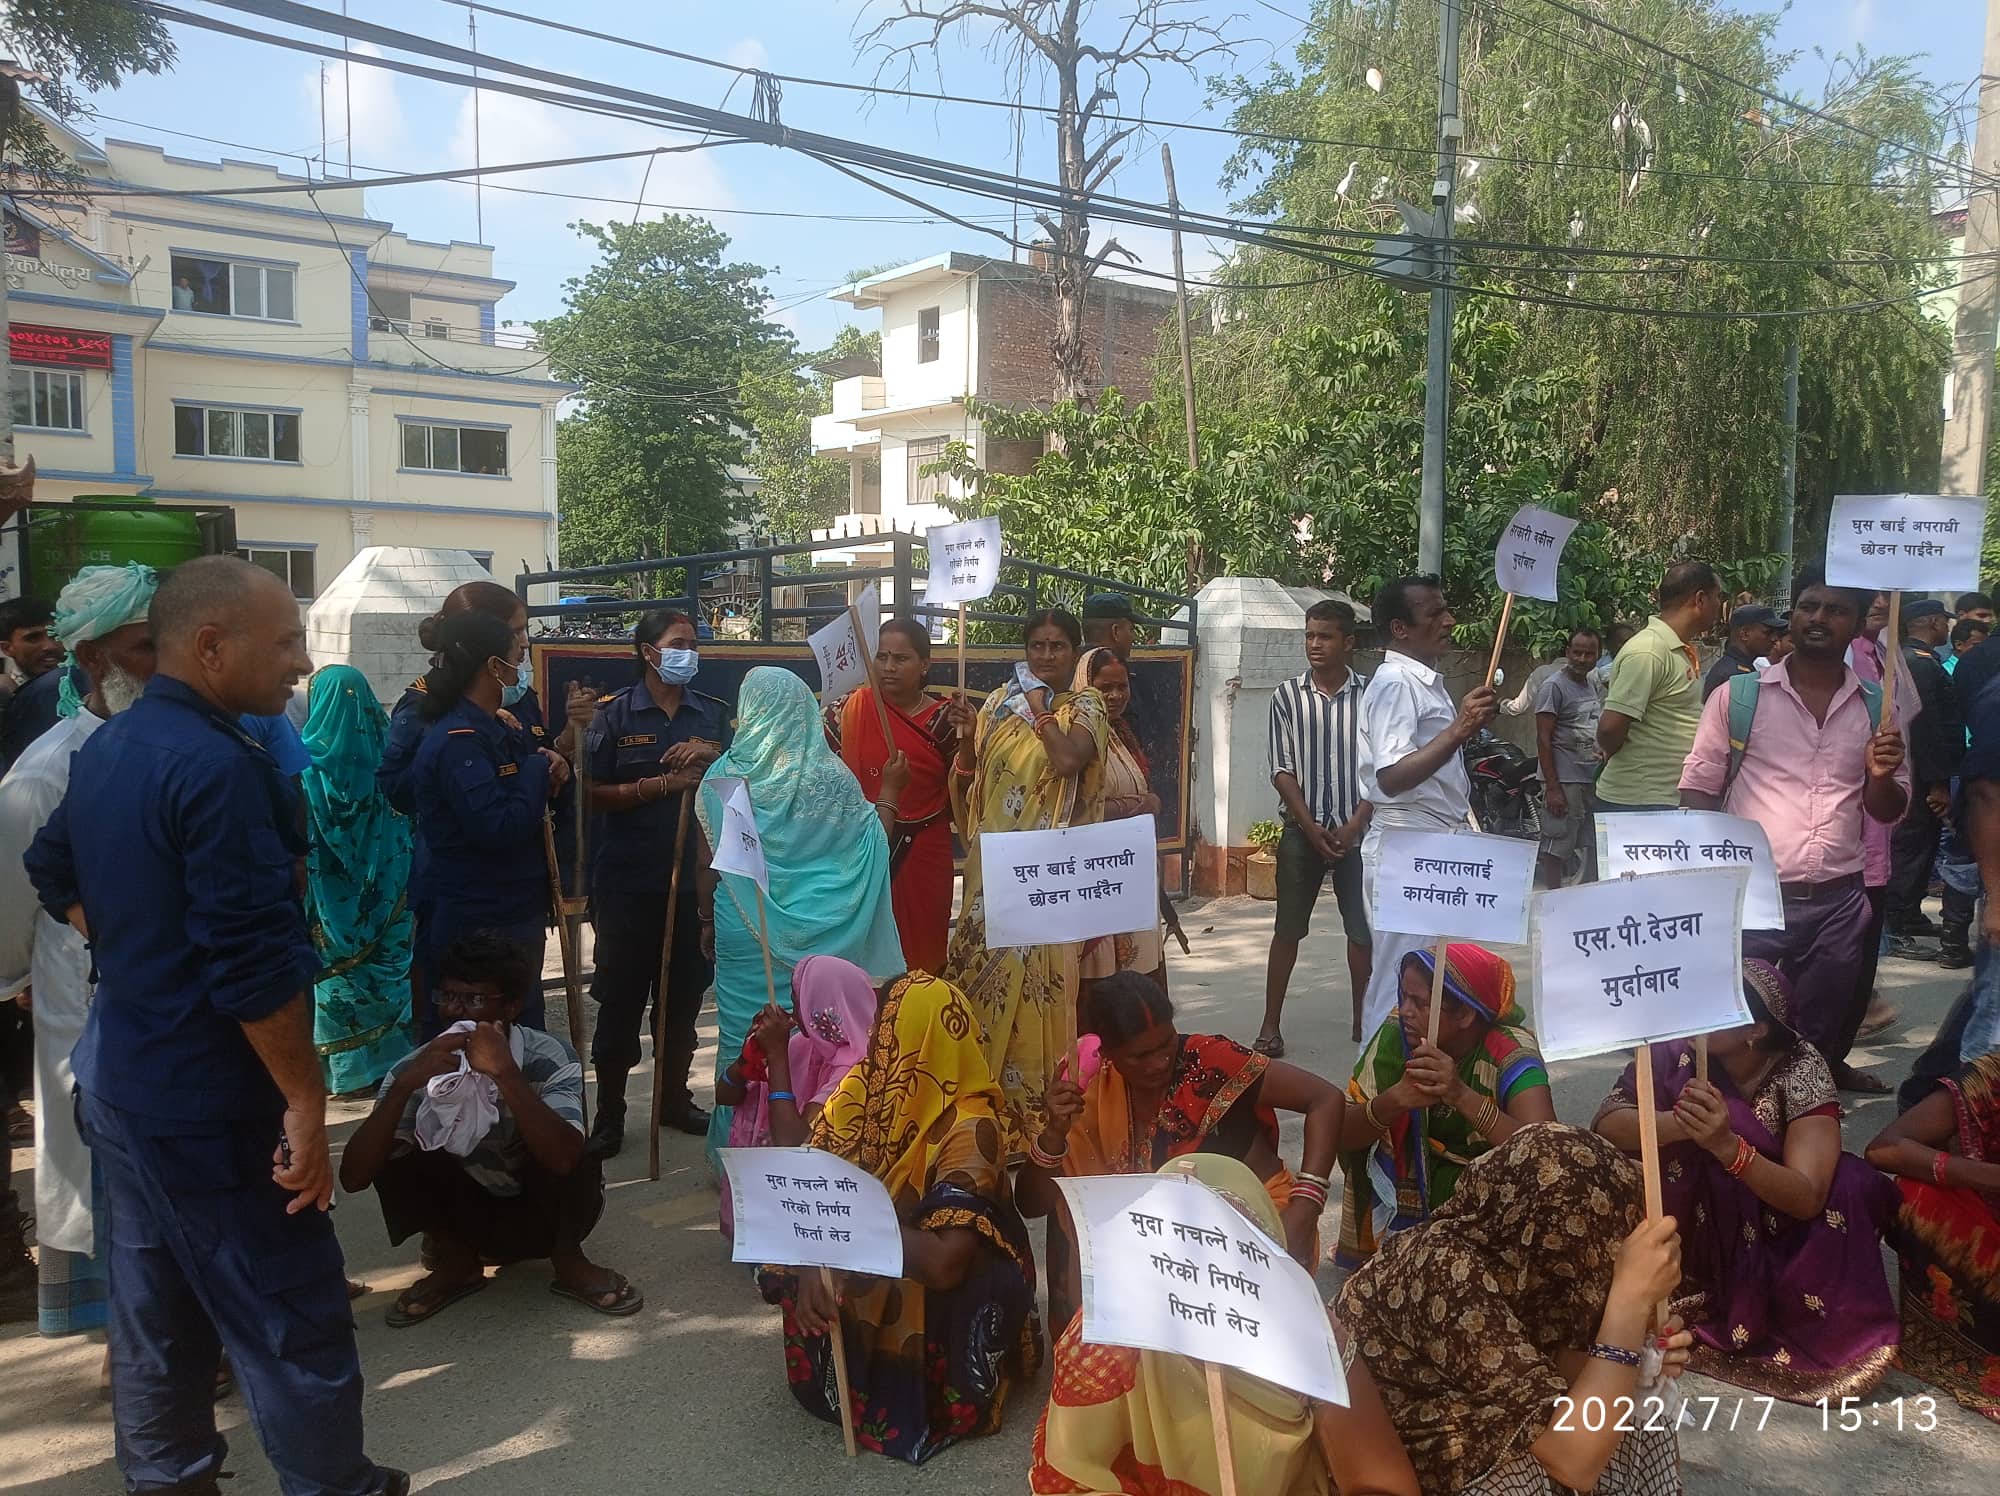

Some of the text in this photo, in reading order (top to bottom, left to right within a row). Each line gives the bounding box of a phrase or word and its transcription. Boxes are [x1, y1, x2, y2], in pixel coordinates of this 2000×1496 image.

[1852, 516, 1960, 535] घुस खाई अपराधी
[1623, 839, 1753, 863] सरकारी वकील
[1013, 848, 1136, 883] घुस खाई अपराधी
[1414, 857, 1494, 881] हत्यारालाई
[1403, 883, 1499, 909] कार्यवाही गर
[1601, 965, 1681, 1007] मुर्दाबाद
[780, 1197, 851, 1217] गरेको निर्णय
[793, 1222, 824, 1241] फिर्ता
[1172, 1221, 1228, 1252] नचल्ने
[1236, 1240, 1271, 1270] भनि
[1150, 1252, 1260, 1300] गरेको निर्णय
[1168, 1293, 1260, 1338] फिर्ता लेउ
